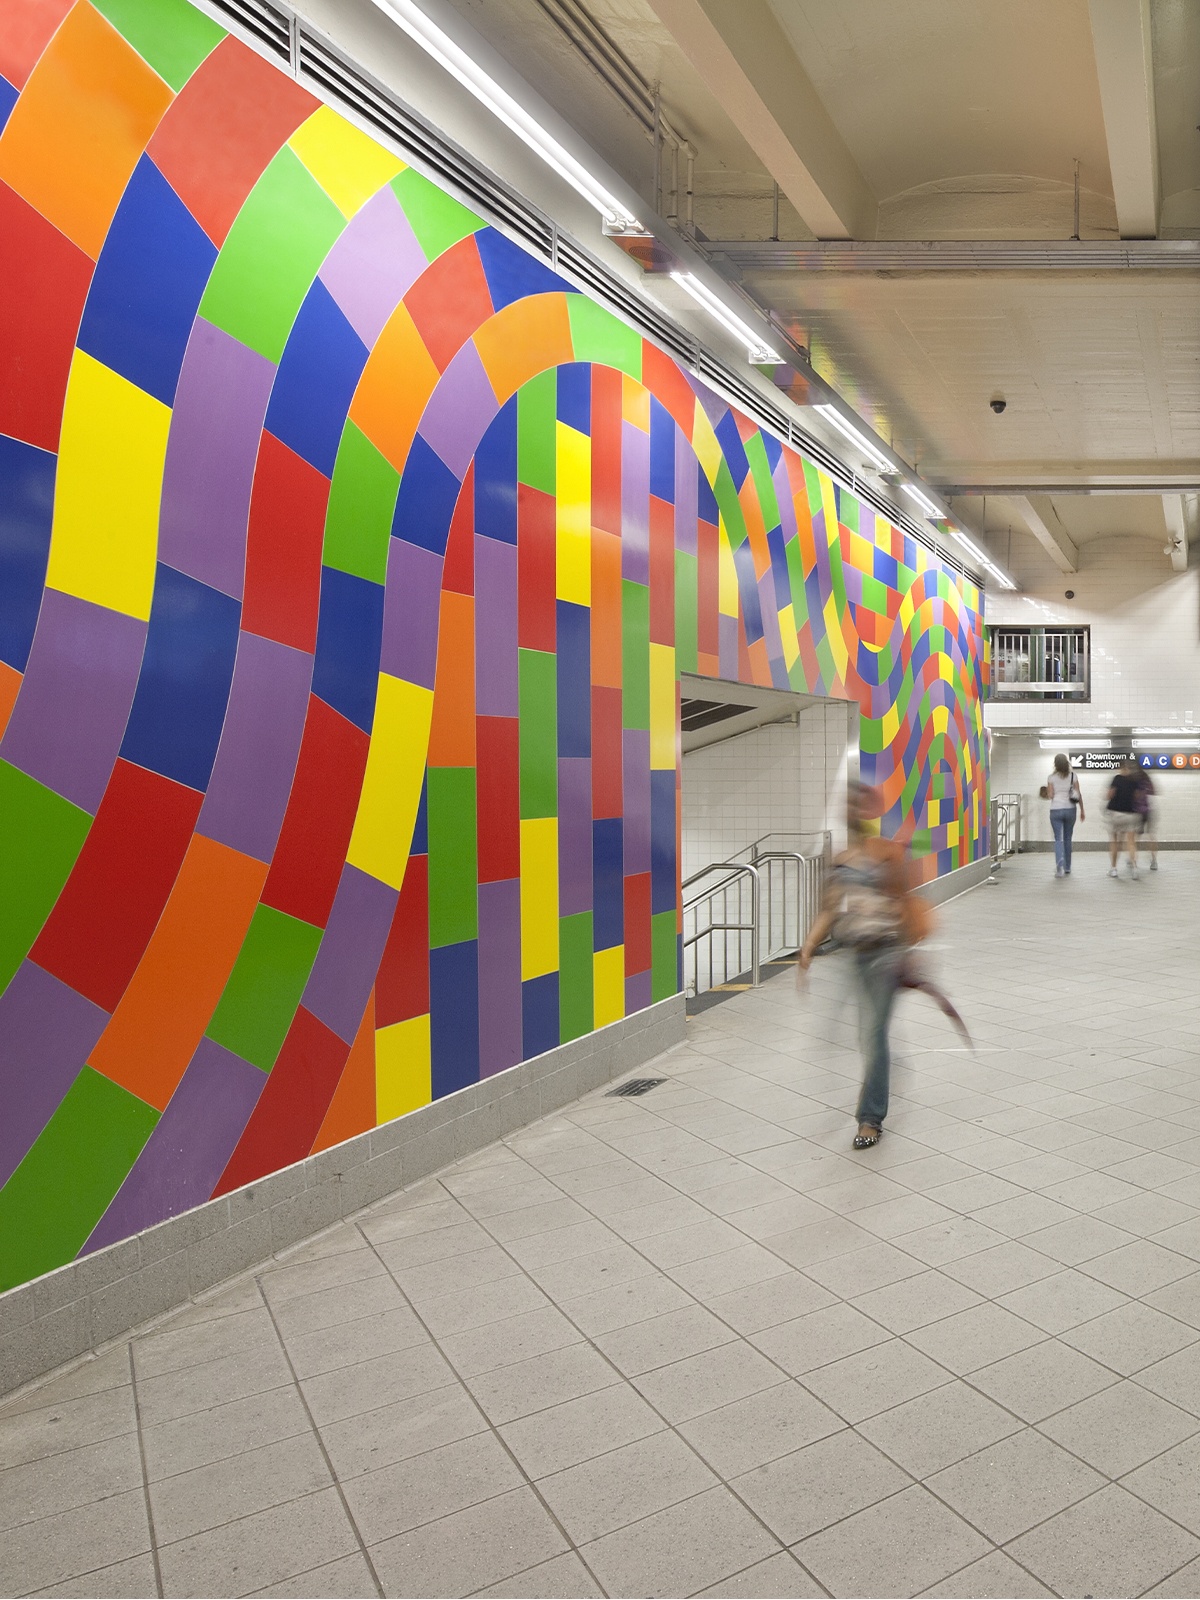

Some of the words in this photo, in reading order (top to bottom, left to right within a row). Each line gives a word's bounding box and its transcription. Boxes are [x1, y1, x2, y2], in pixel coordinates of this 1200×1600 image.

[1086, 752, 1127, 760] Downtown
[1129, 752, 1136, 760] &
[1086, 760, 1120, 769] Brooklyn
[1142, 756, 1151, 766] A
[1158, 756, 1167, 766] C
[1176, 756, 1184, 766] B
[1192, 756, 1200, 766] D
